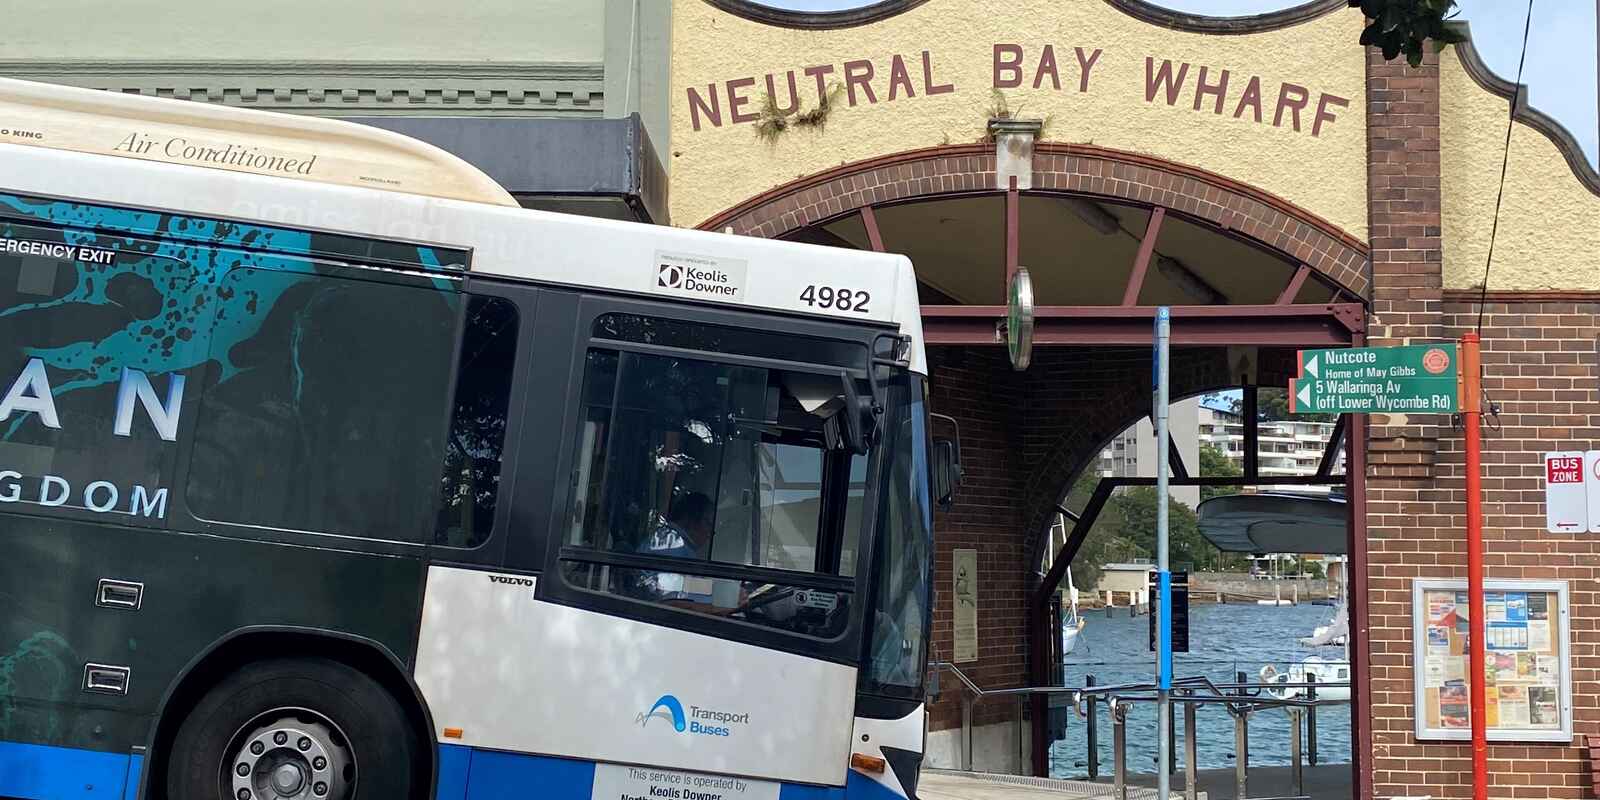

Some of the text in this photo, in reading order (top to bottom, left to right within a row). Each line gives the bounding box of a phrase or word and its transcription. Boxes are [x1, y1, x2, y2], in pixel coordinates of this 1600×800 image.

[686, 43, 1350, 138] NEUTRAL BAY WHARF
[13, 130, 43, 139] KING
[112, 131, 317, 175] Air Conditioned
[78, 248, 115, 264] EXIT
[686, 267, 727, 283] Keolis
[685, 279, 738, 295] Downer
[800, 284, 870, 314] 4982
[1325, 350, 1376, 364] Nutcote
[1325, 366, 1416, 379] Home of May Gibbs
[1315, 380, 1401, 396] 5 Wallaringa Av
[1316, 394, 1451, 411] (off Lower Wycombe Rd)
[1552, 459, 1578, 470] BUS
[1552, 471, 1578, 482] ZONE
[488, 575, 533, 586] VOLVO
[690, 706, 750, 724] Transport
[690, 721, 729, 737] Buses
[628, 767, 747, 792] This service is operated by
[649, 785, 681, 799] Keolis
[683, 789, 722, 800] Downer
